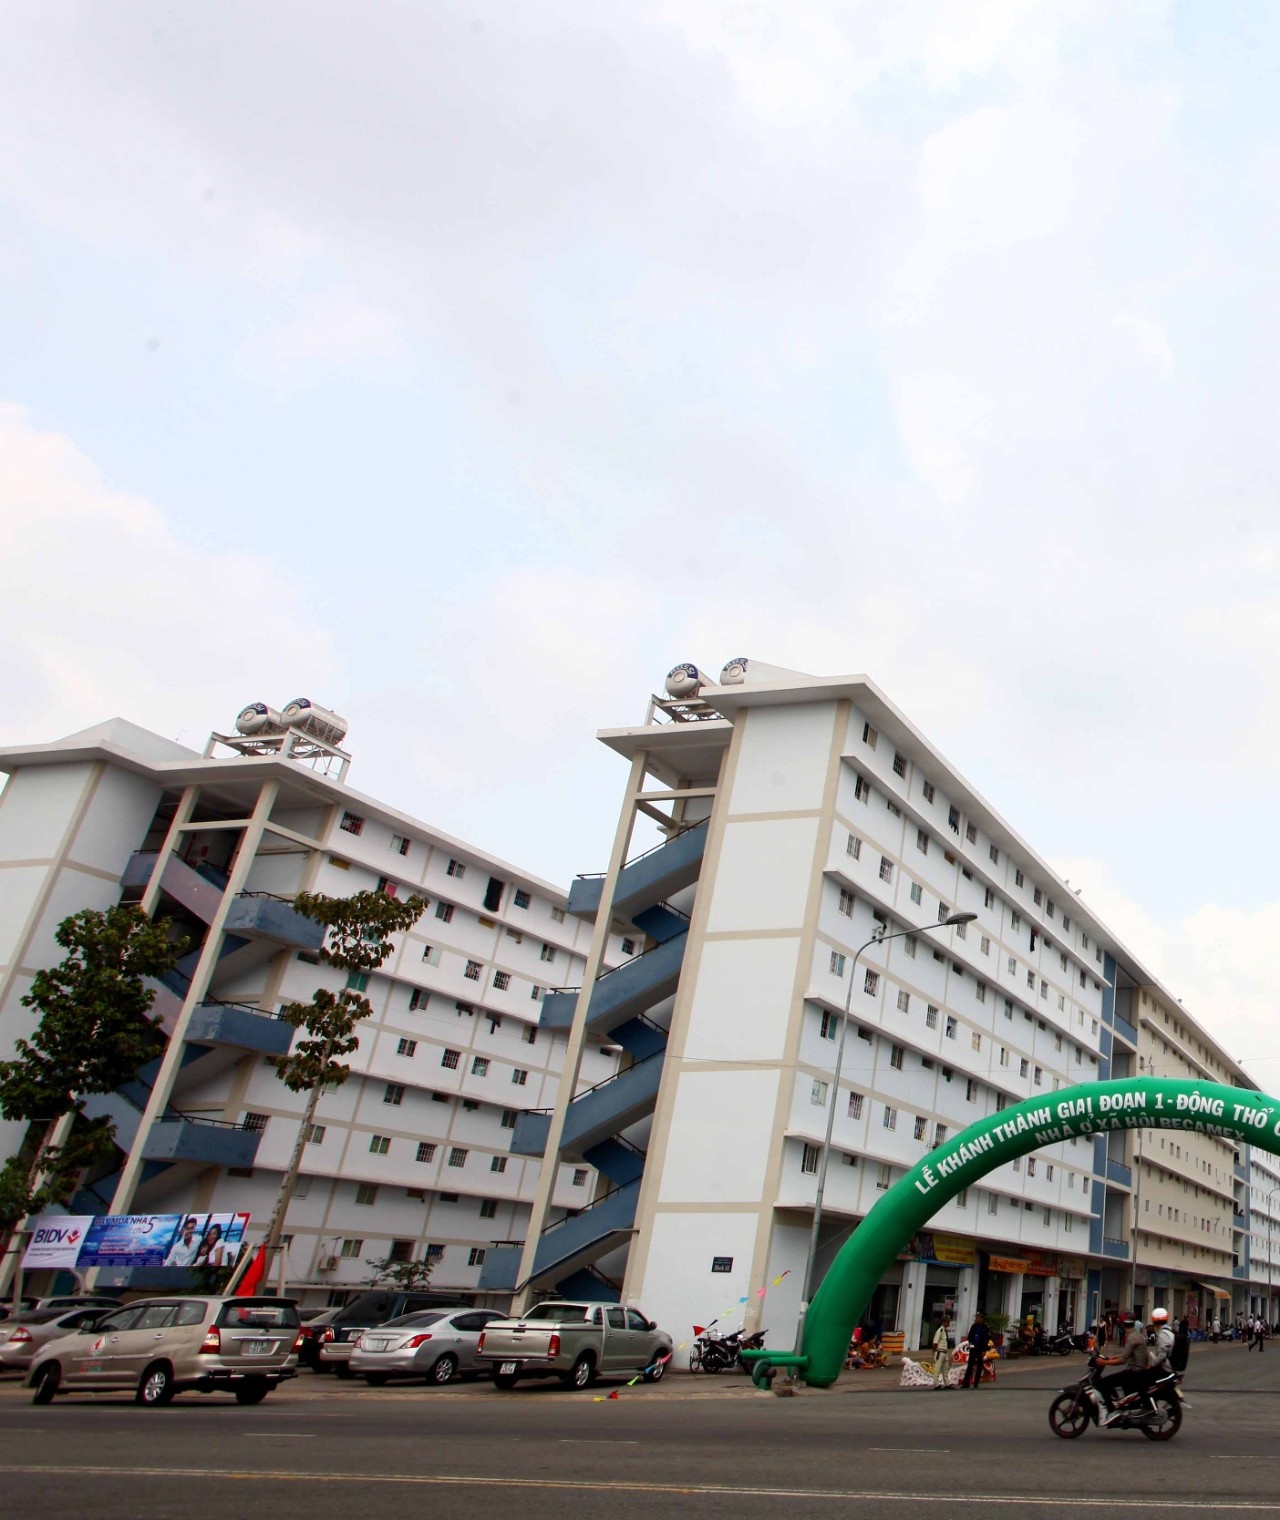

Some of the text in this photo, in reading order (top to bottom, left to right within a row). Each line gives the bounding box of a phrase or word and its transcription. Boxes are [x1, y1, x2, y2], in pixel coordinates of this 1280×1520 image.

[914, 1164, 939, 1195] LỄ
[936, 1132, 994, 1178] KHÁNH
[992, 1107, 1052, 1143] THÀNH
[1057, 1096, 1092, 1119] GIAI
[1099, 1091, 1146, 1112] ĐOẠN
[1233, 1104, 1275, 1129] THỔ
[1035, 1120, 1075, 1145] NHÀ
[1159, 1117, 1245, 1142] BECAMEX
[34, 1229, 69, 1244] BIDV
